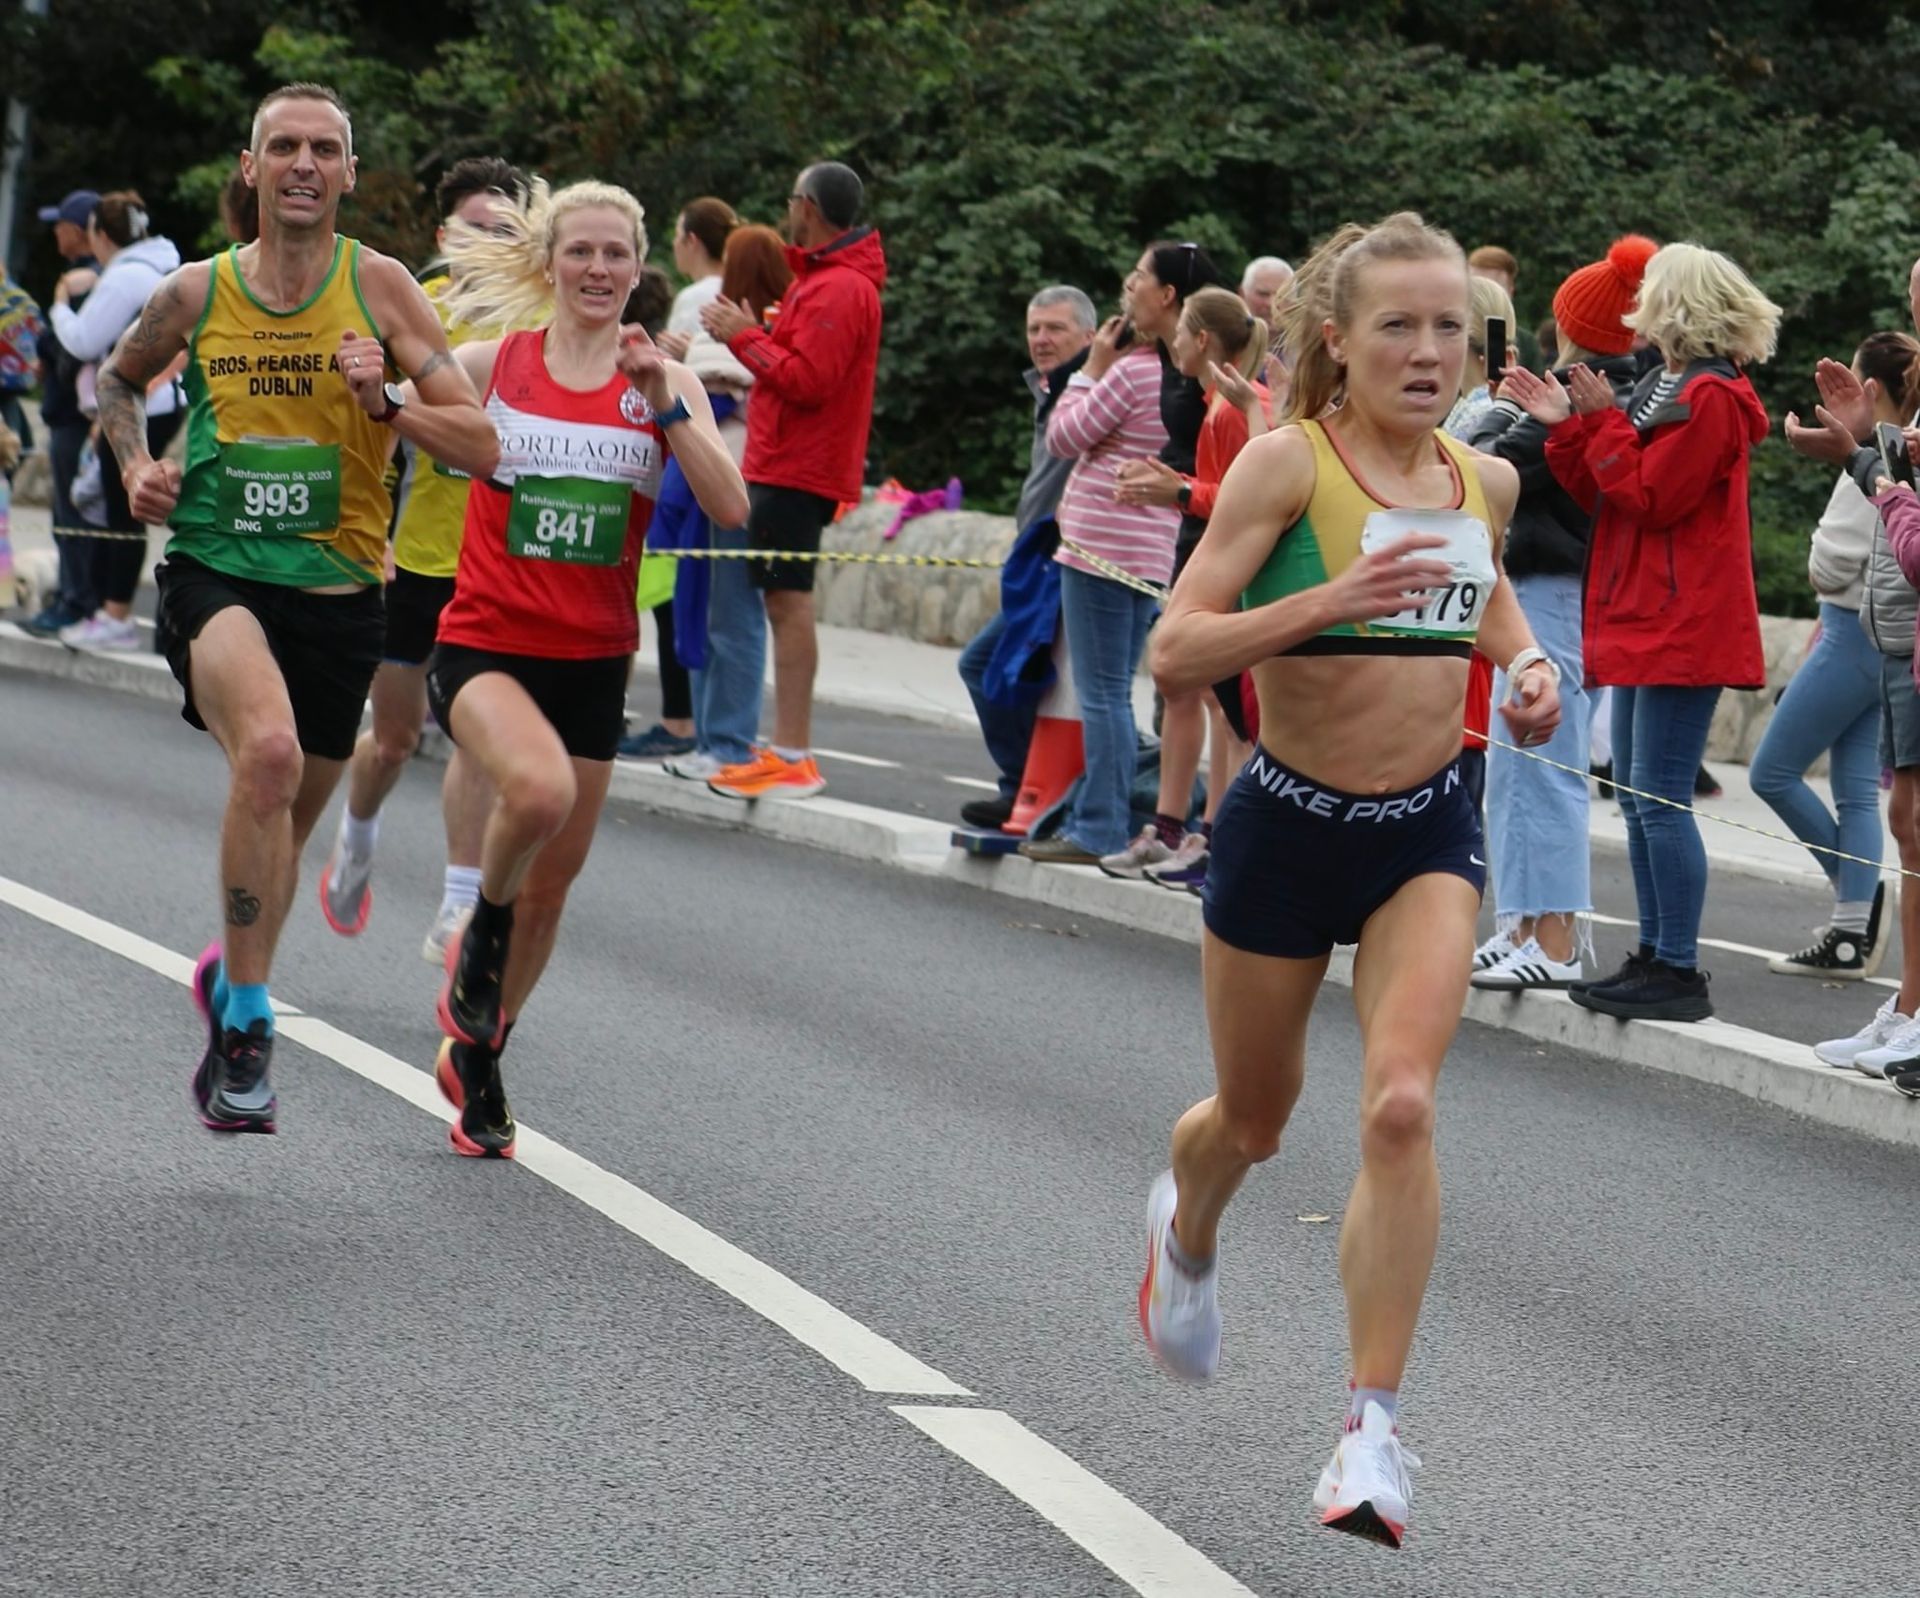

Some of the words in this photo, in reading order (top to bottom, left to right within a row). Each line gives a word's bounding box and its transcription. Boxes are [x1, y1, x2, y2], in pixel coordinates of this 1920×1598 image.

[209, 355, 252, 377] BROS.
[257, 354, 323, 372] PEARSE
[249, 377, 312, 396] DUBLIN
[225, 466, 290, 480] Rathfarnham
[307, 470, 333, 481] 2023
[530, 455, 578, 471] Athletic
[585, 459, 618, 475] Club
[244, 481, 310, 517] 993
[520, 492, 583, 512] Rathfarnham
[234, 518, 262, 533] DNG
[536, 508, 595, 547] 841
[523, 541, 551, 558] DNG
[1250, 755, 1342, 818] NIKE
[1343, 788, 1434, 823] PRO
